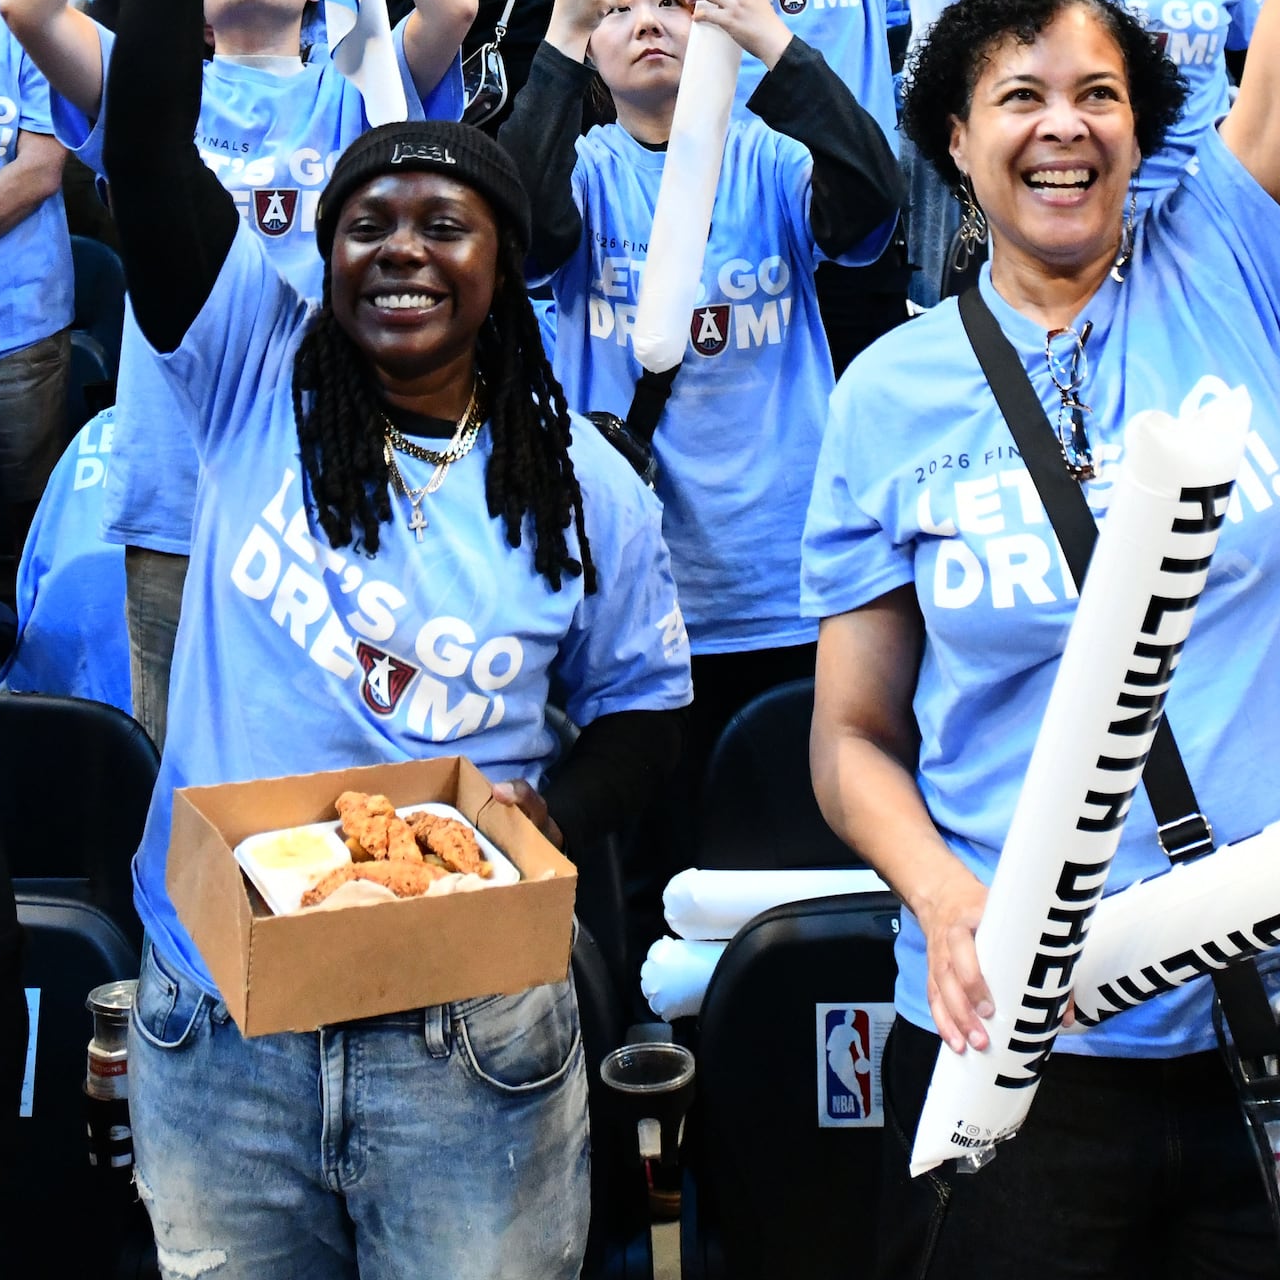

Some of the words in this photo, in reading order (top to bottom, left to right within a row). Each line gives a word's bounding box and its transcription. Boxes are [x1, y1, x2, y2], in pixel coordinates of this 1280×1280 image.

[1161, 0, 1219, 32] GO
[717, 254, 791, 300] GO
[915, 452, 970, 483] 2026
[415, 615, 524, 690] GO
[993, 858, 1113, 1091] DREAM
[832, 1095, 855, 1113] NBA
